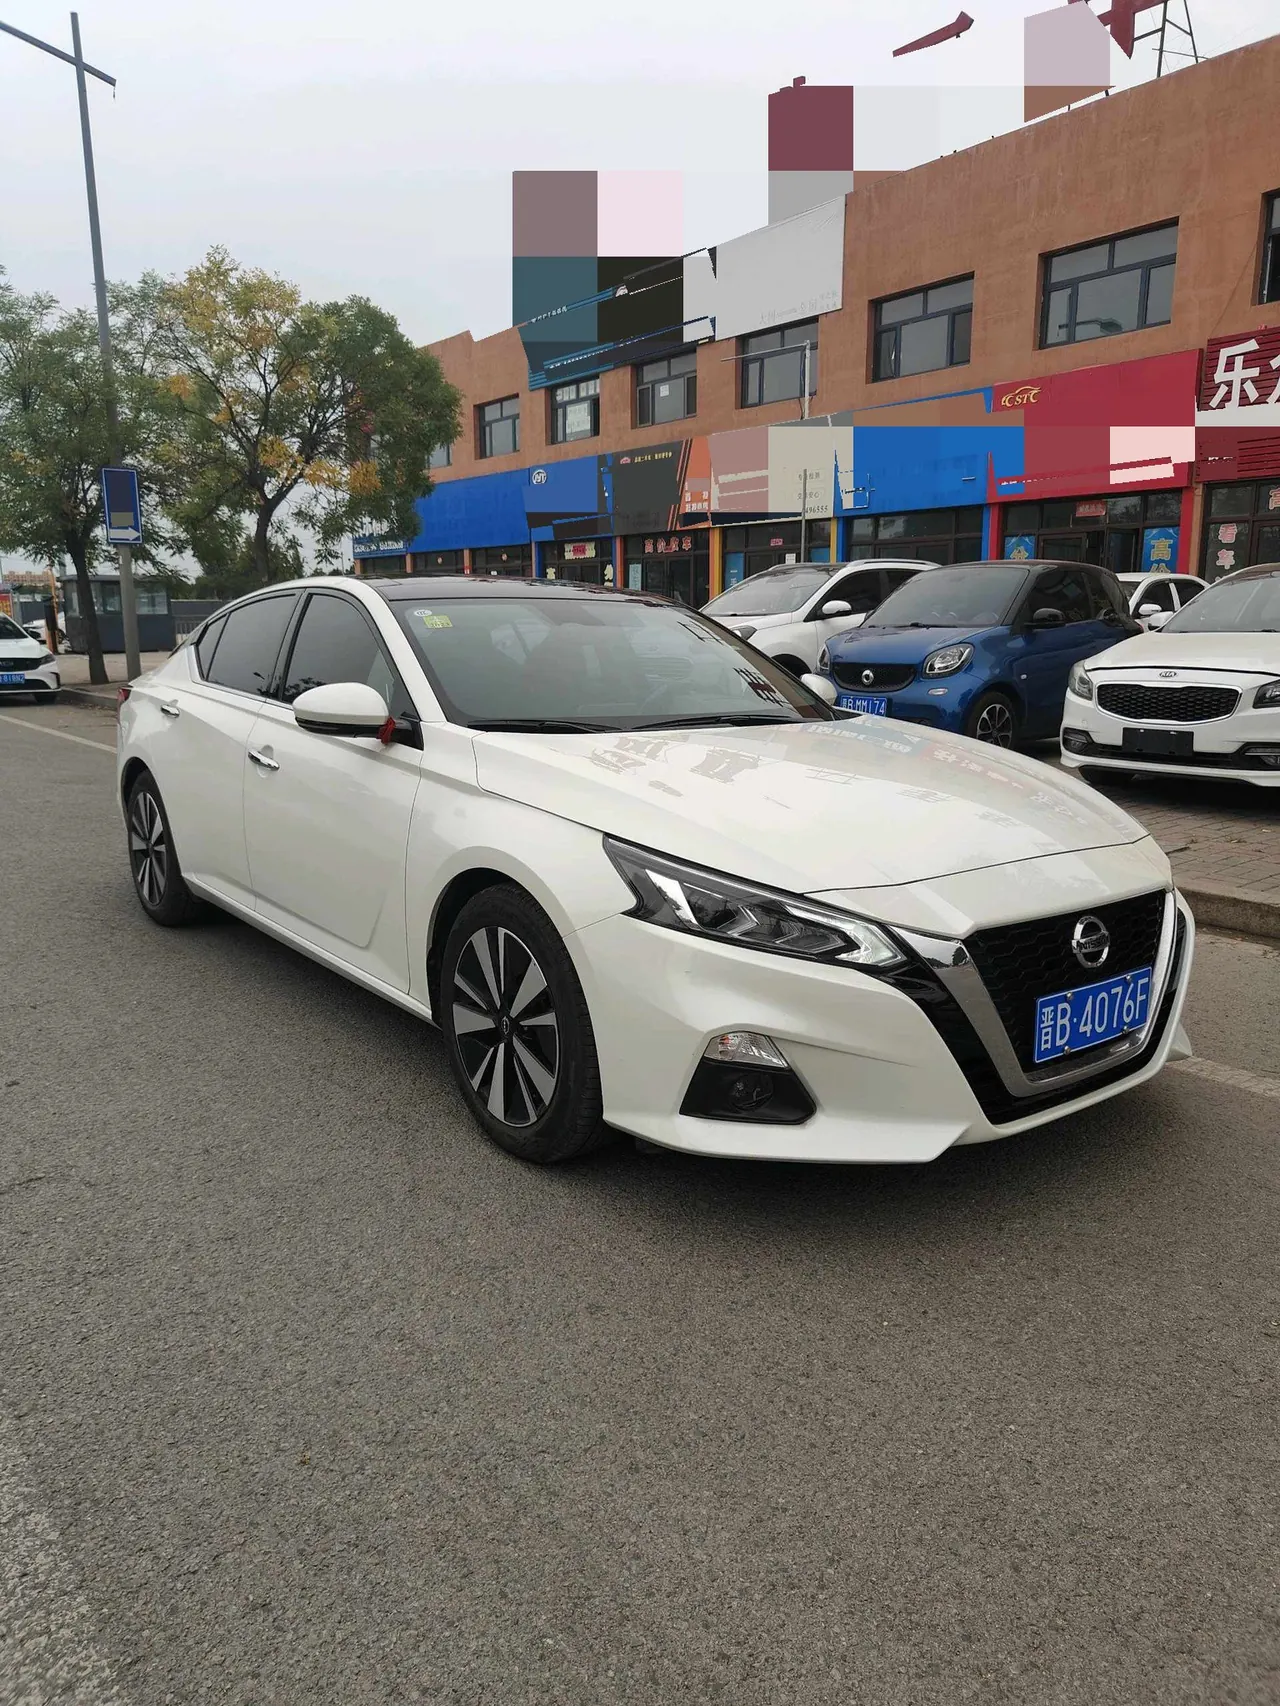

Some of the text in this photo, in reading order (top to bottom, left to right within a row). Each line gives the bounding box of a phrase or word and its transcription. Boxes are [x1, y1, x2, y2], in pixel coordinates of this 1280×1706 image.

[1209, 338, 1280, 408] 乐
[797, 491, 820, 500] 交安心
[798, 471, 820, 481] 专检测
[1040, 976, 1150, 1052] 晋B·4076F
